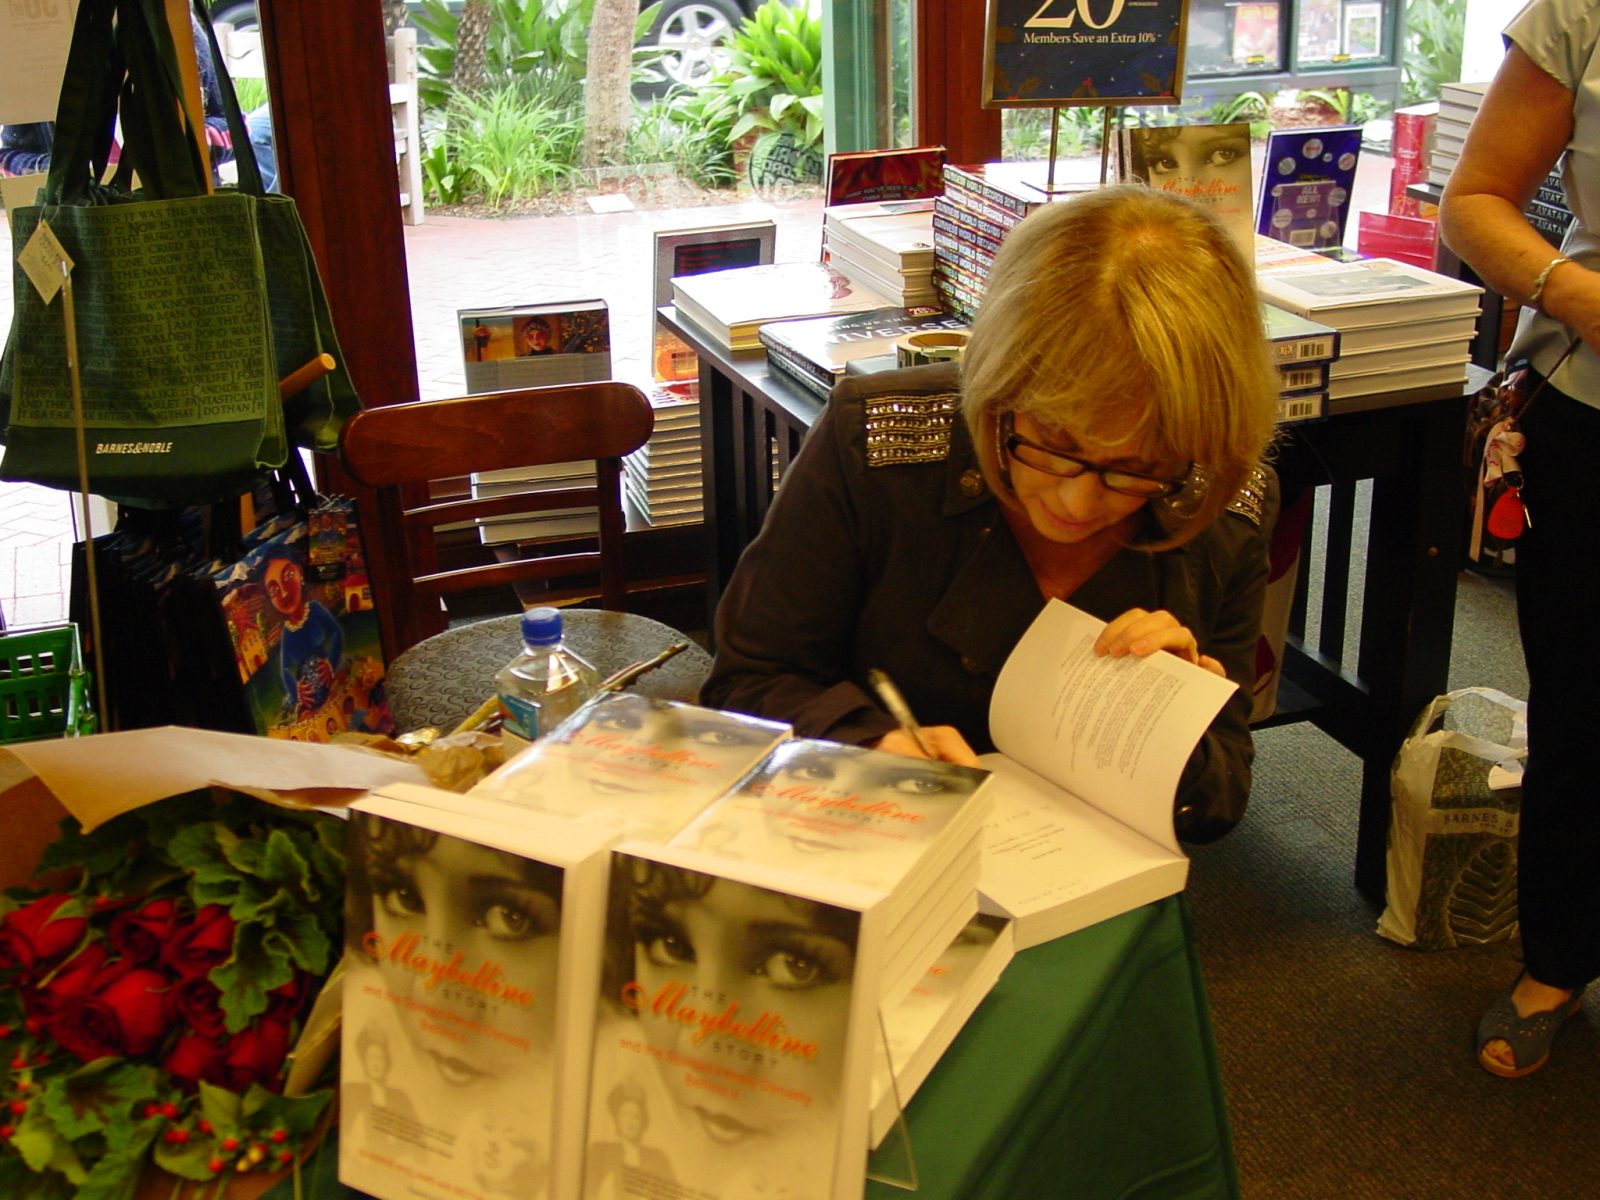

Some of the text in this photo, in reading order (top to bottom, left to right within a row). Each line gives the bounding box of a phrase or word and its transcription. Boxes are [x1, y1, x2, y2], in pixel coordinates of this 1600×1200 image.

[1024, 32, 1070, 43] Members
[1073, 32, 1095, 43] Save
[1097, 35, 1108, 43] an
[1111, 32, 1136, 43] Extra
[982, 186, 1004, 204] RECORDS
[1301, 186, 1318, 194] ALL
[1536, 206, 1568, 222] AVATAR
[752, 783, 925, 822] Maybelline
[362, 928, 533, 1008] Maybelline
[443, 988, 499, 1014] STORY
[692, 986, 726, 1004] THE
[621, 979, 818, 1060] Maybelline
[713, 1042, 778, 1066] STORY
